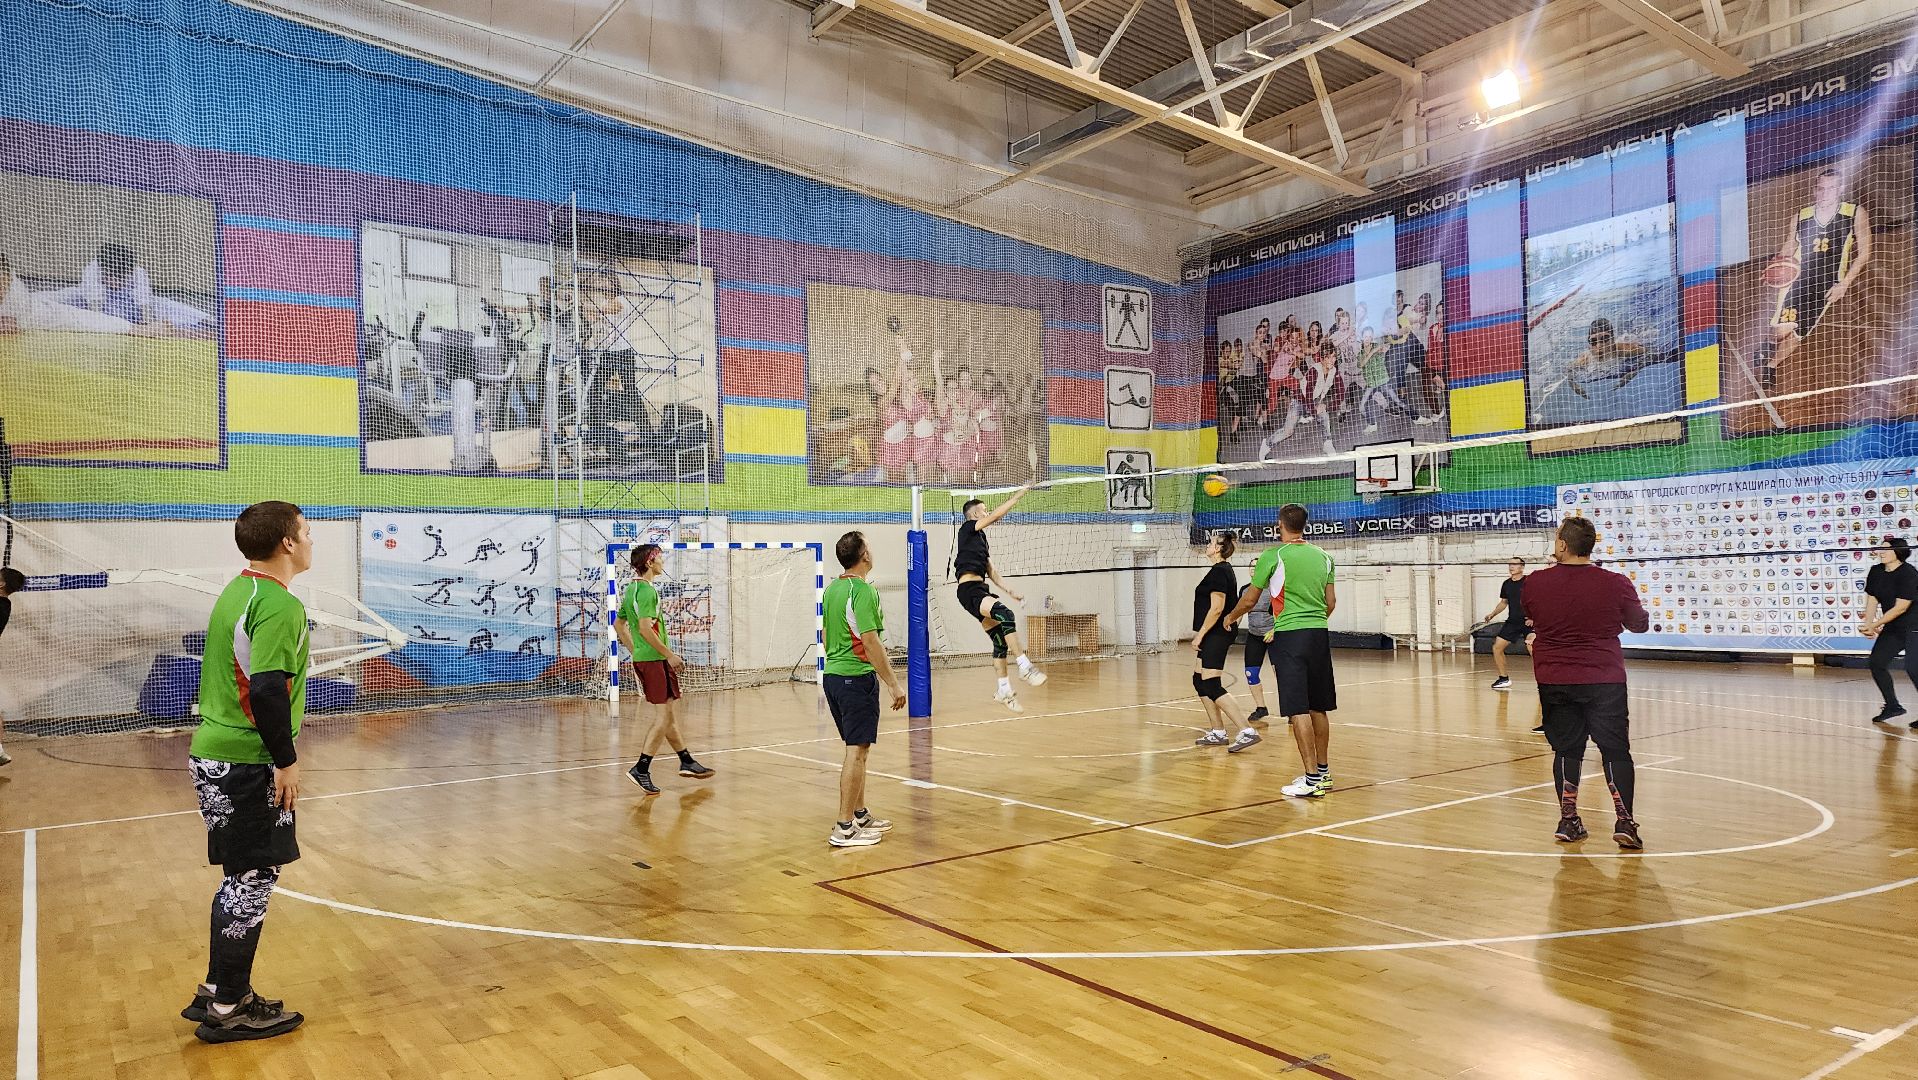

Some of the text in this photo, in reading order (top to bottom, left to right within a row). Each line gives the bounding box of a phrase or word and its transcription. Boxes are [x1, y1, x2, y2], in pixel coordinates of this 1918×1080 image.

[1185, 255, 1241, 281] ФИНИШ
[1250, 230, 1326, 261] ЧЕМПИОН
[1336, 210, 1393, 237] ПОЛЕТ
[1406, 177, 1510, 217] СКОРОСТЬ
[1525, 155, 1585, 183] ЦЕЛЬ
[1602, 121, 1692, 160] МЕЧТА
[1712, 74, 1847, 127] ЭНЕРГИЯ
[1592, 489, 1638, 501] ЧЕМПИОНАТ
[1641, 485, 1696, 499] ГОРОДСКОГО
[1698, 482, 1733, 495] ОКРУГА
[1735, 478, 1777, 492] КАШИРА
[1778, 478, 1793, 490] ПО
[1355, 516, 1416, 533] УСПЕХ
[1428, 510, 1521, 529] ЭНЕРГИЯ
